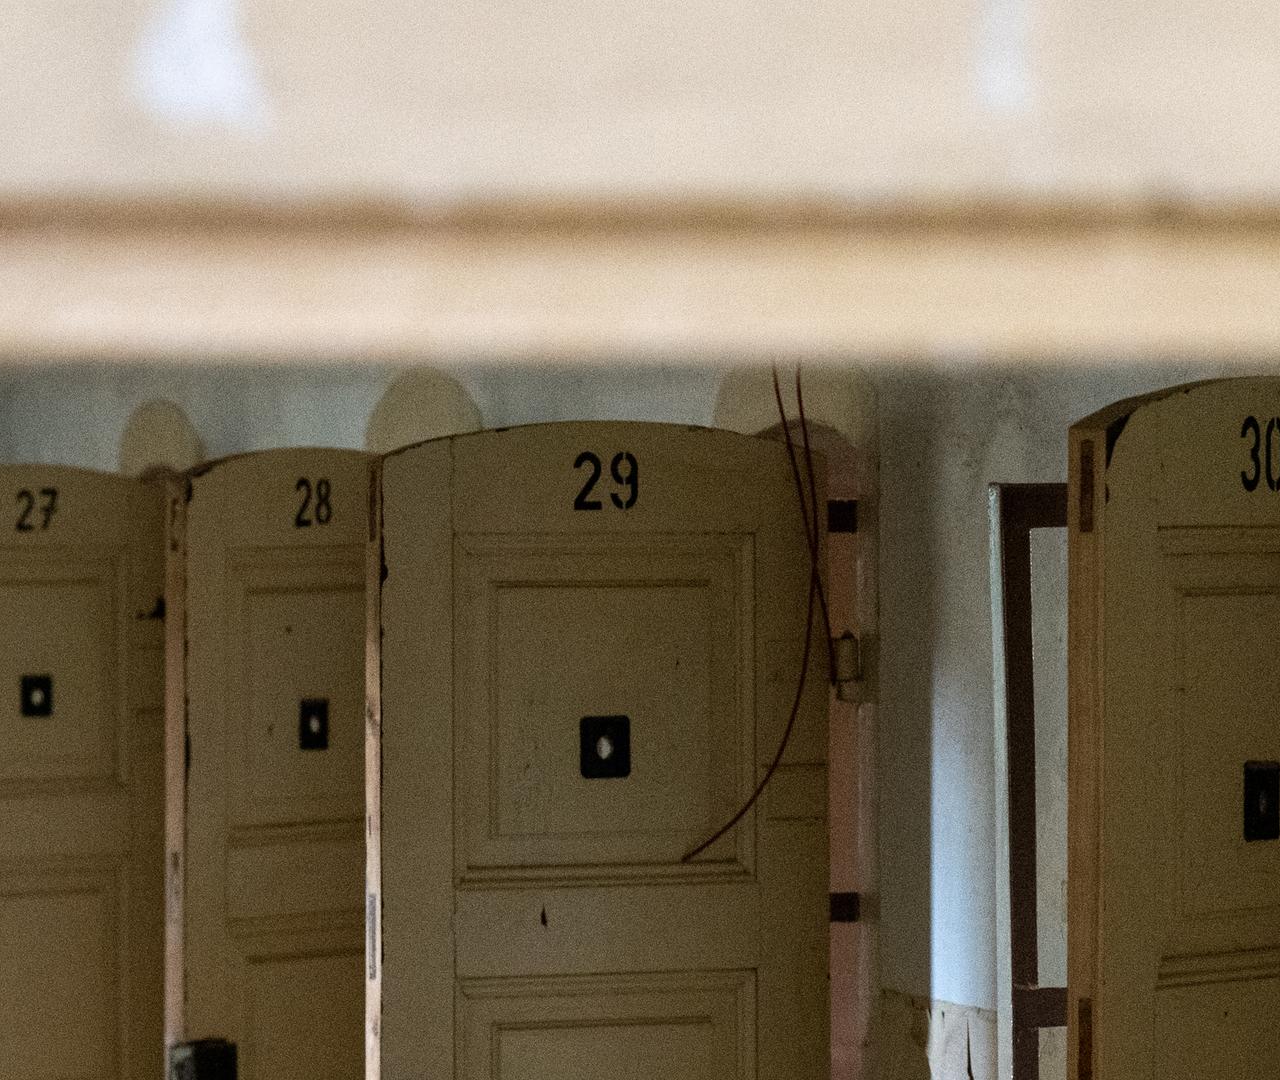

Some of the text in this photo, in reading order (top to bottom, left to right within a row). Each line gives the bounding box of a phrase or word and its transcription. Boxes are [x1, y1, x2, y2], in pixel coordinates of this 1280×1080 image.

[294, 477, 333, 528] 28
[574, 452, 639, 512] 29
[15, 487, 59, 532] 27
